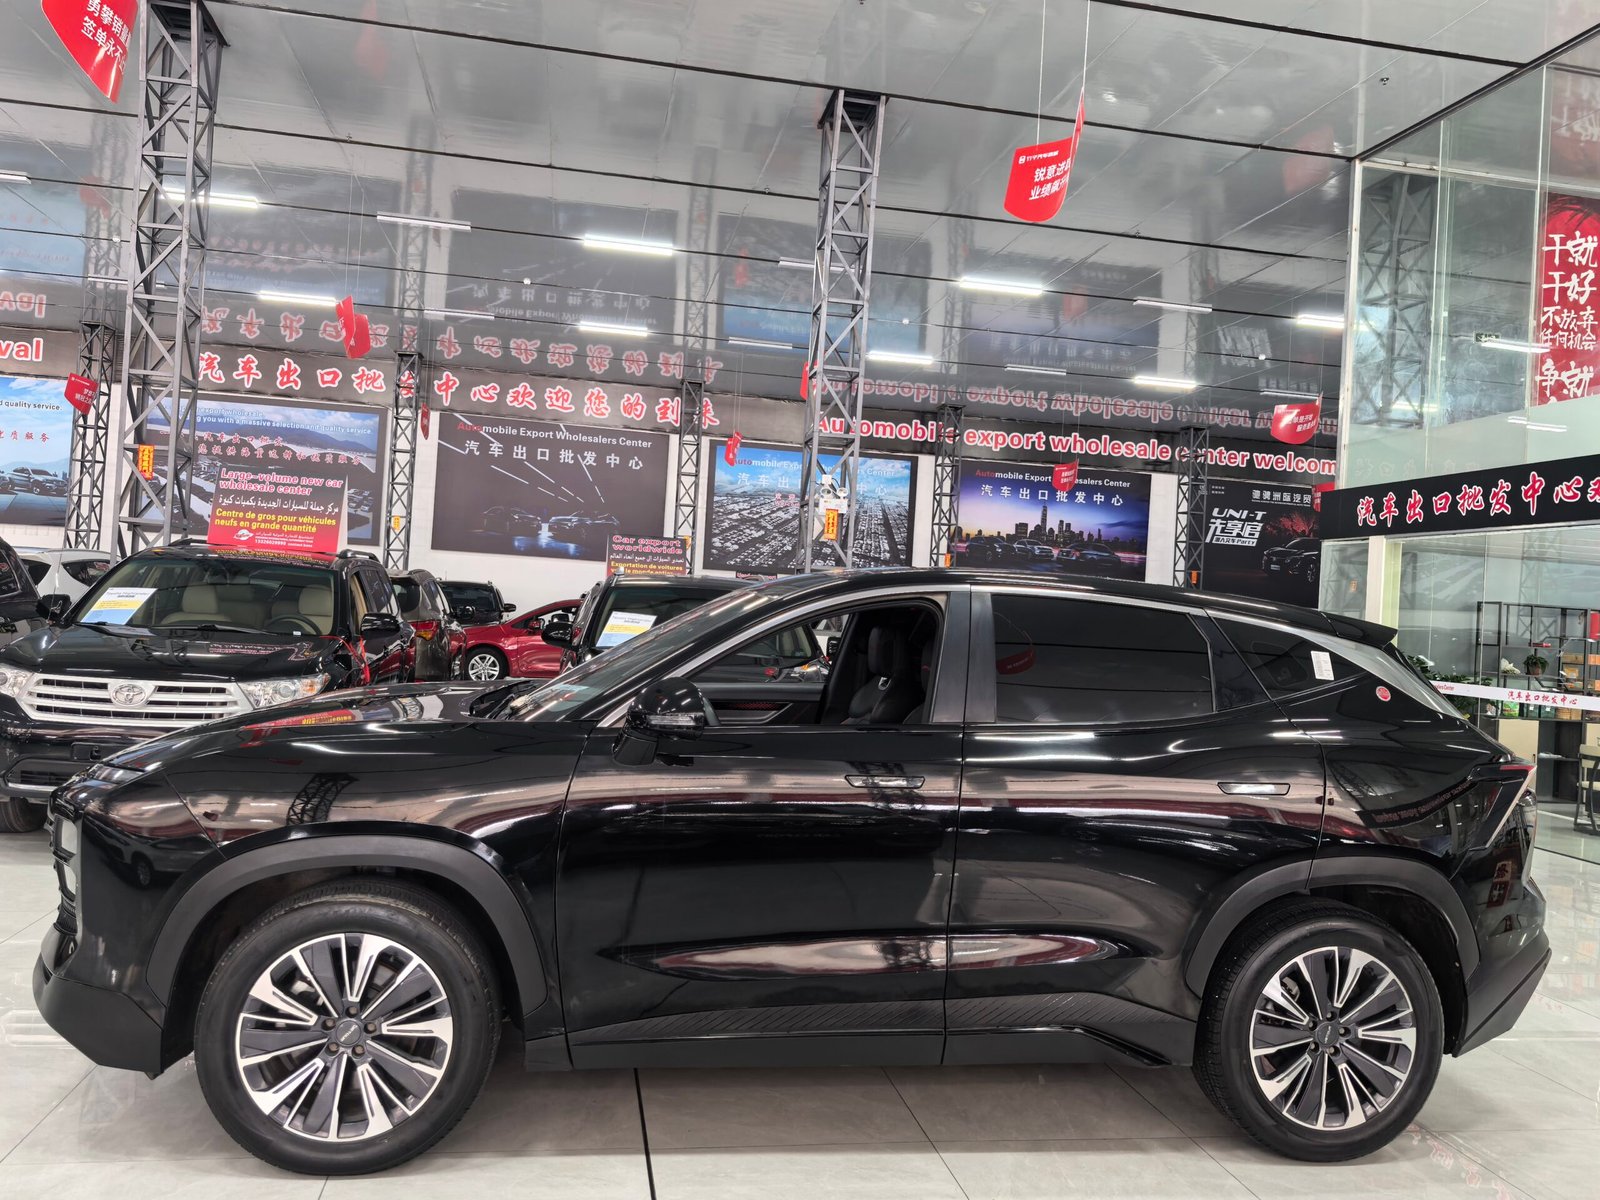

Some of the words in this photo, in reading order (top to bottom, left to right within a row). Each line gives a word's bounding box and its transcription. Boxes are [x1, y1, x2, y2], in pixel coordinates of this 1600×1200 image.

[87, 0, 131, 48] 勇攀销量
[1541, 270, 1598, 304] 干好
[1541, 306, 1598, 334] 不放弃
[1539, 328, 1597, 351] 任何机会
[4, 401, 31, 409] quality
[33, 403, 62, 411] service.
[203, 416, 217, 424] you
[241, 419, 271, 427] massive
[272, 421, 307, 429] selection
[320, 424, 345, 433] quality
[457, 421, 517, 435] Automobile
[520, 427, 554, 439] Export
[556, 431, 617, 445] Wholesalers
[619, 437, 653, 449] Center
[964, 428, 1046, 452] export
[1050, 433, 1171, 461] wholesale
[465, 440, 643, 470] 汽车出口批发中心
[735, 458, 781, 469] utomobile
[220, 468, 299, 485] Large-volume
[300, 474, 324, 487] new
[325, 477, 344, 488] car
[976, 468, 1024, 482] Automobile
[1024, 473, 1053, 484] Export
[1103, 479, 1131, 489] Center
[219, 479, 275, 492] wholesale
[276, 484, 312, 496] center
[981, 484, 1123, 506] 汽车出口批发中心
[216, 508, 244, 519] Centre
[245, 510, 256, 520] de
[257, 513, 276, 523] gros
[277, 514, 298, 525] pour
[298, 512, 337, 526] véhicules
[1212, 508, 1267, 521] UNI-T
[215, 518, 238, 528] neufs
[239, 520, 250, 528] en
[251, 521, 281, 532] grande
[282, 522, 317, 534] quantité
[612, 535, 636, 544] Car
[637, 537, 681, 547] export
[612, 544, 683, 555] worldwide
[611, 561, 648, 569] Exportation
[1507, 690, 1578, 706] 汽车出口批发中心
